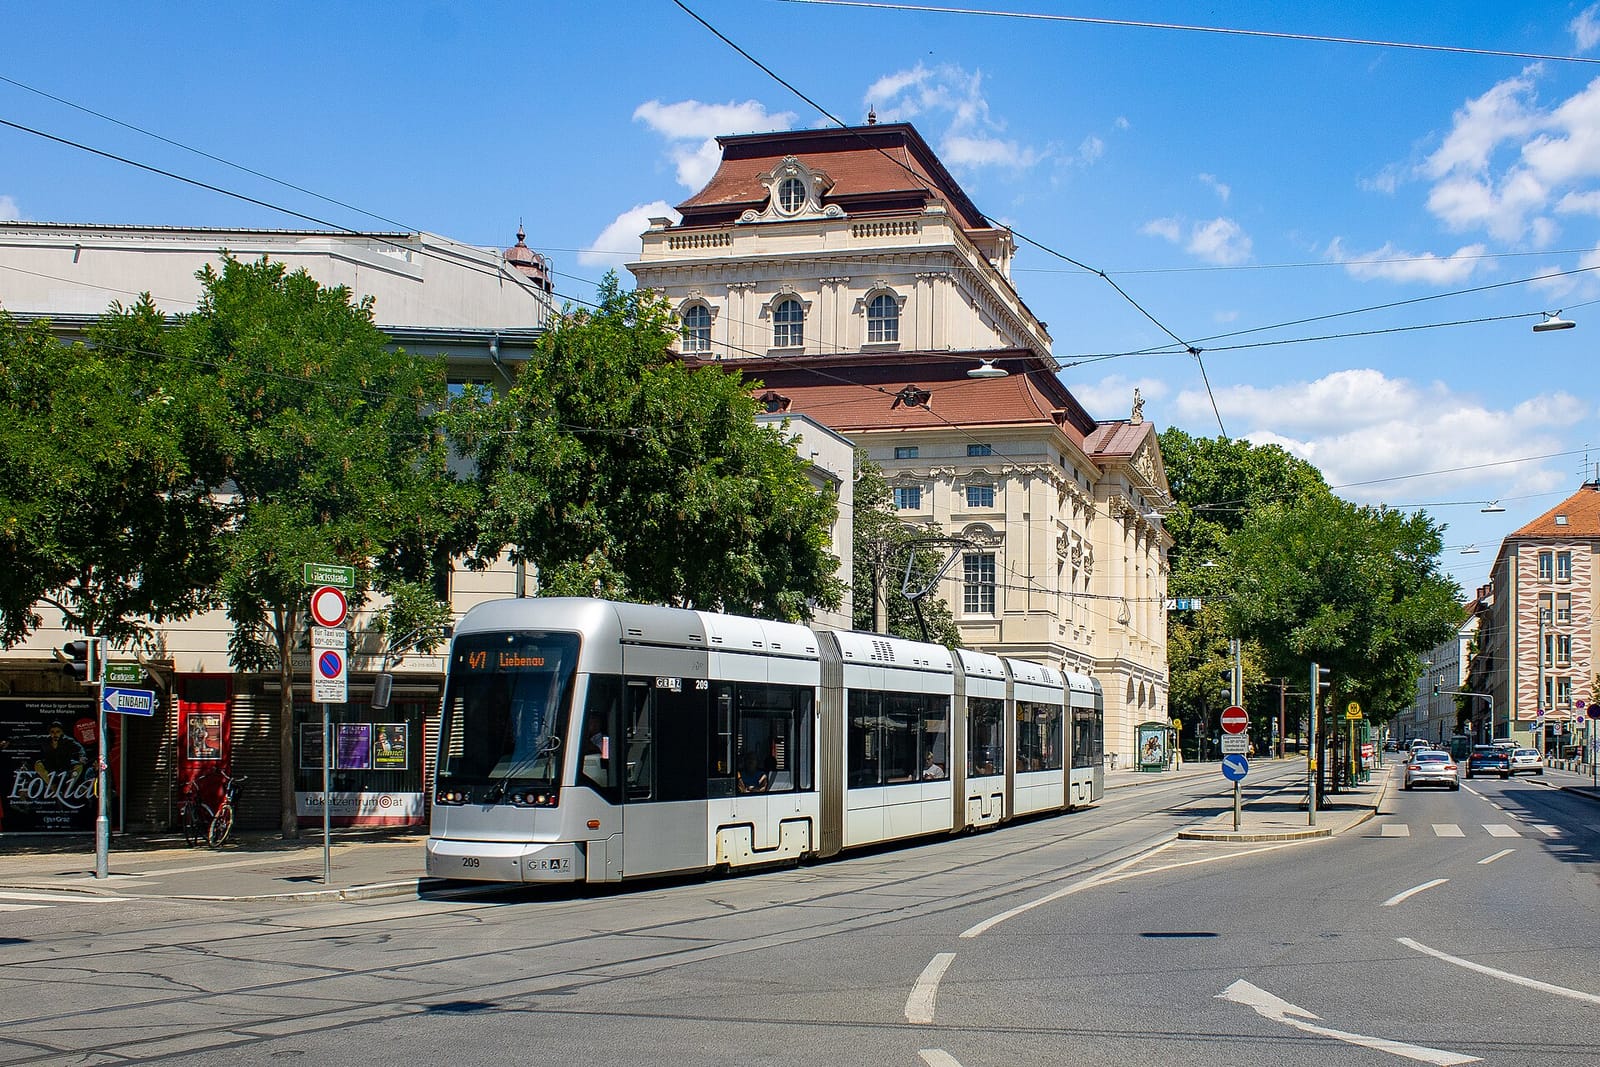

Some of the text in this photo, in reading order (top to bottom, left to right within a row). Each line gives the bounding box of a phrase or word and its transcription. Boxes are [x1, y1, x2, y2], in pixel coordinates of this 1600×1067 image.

[469, 652, 544, 668] 4/7 Liebenau
[656, 677, 708, 690] GRAZ 209
[118, 695, 149, 709] EINBAHN
[7, 770, 98, 808] Follia
[462, 858, 570, 870] 209 GRAZ
